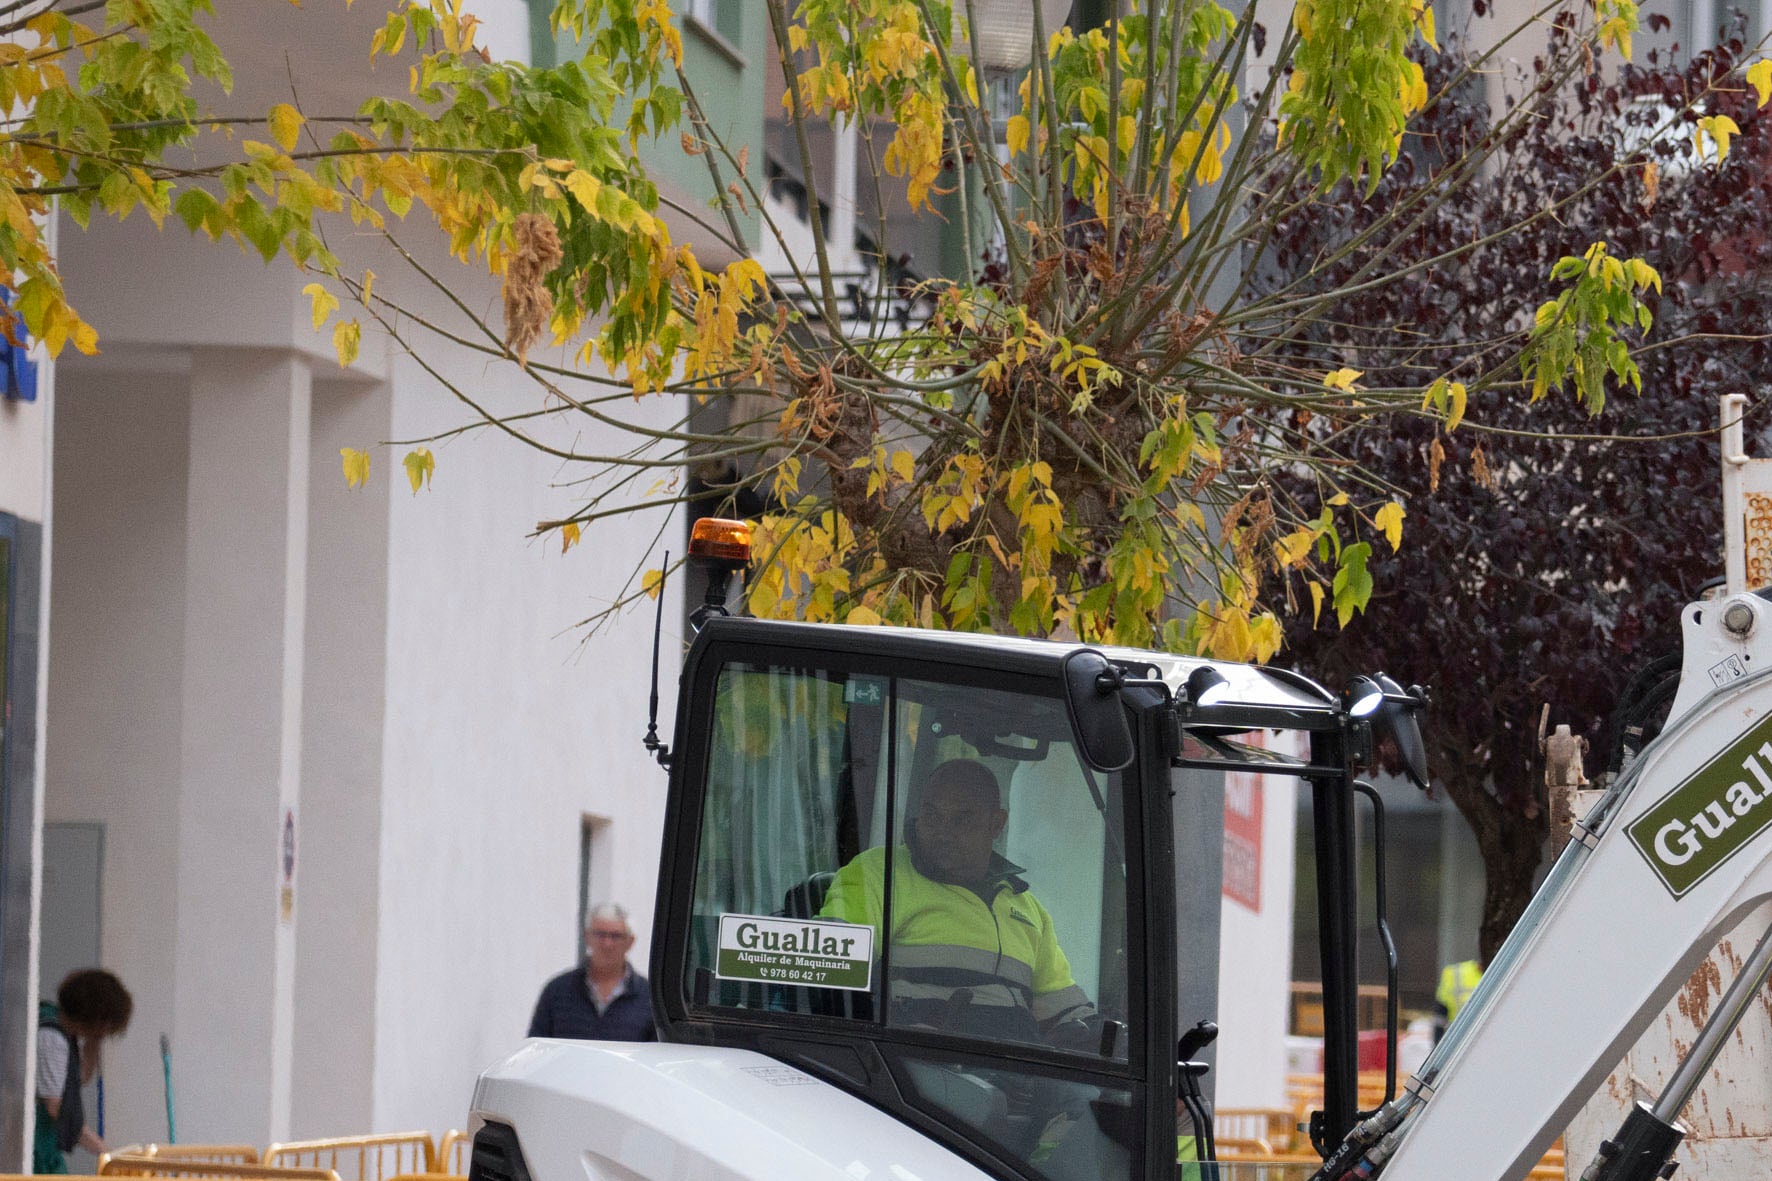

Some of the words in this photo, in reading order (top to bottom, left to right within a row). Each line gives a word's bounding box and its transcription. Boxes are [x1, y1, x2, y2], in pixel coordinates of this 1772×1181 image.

[736, 923, 855, 957] Guallar
[737, 952, 777, 965] Alquiler
[780, 955, 792, 965] de
[795, 957, 851, 970] Maquinaria
[770, 968, 787, 979] 978
[788, 970, 800, 980] 60
[802, 971, 813, 981] 42
[816, 972, 827, 982] 17
